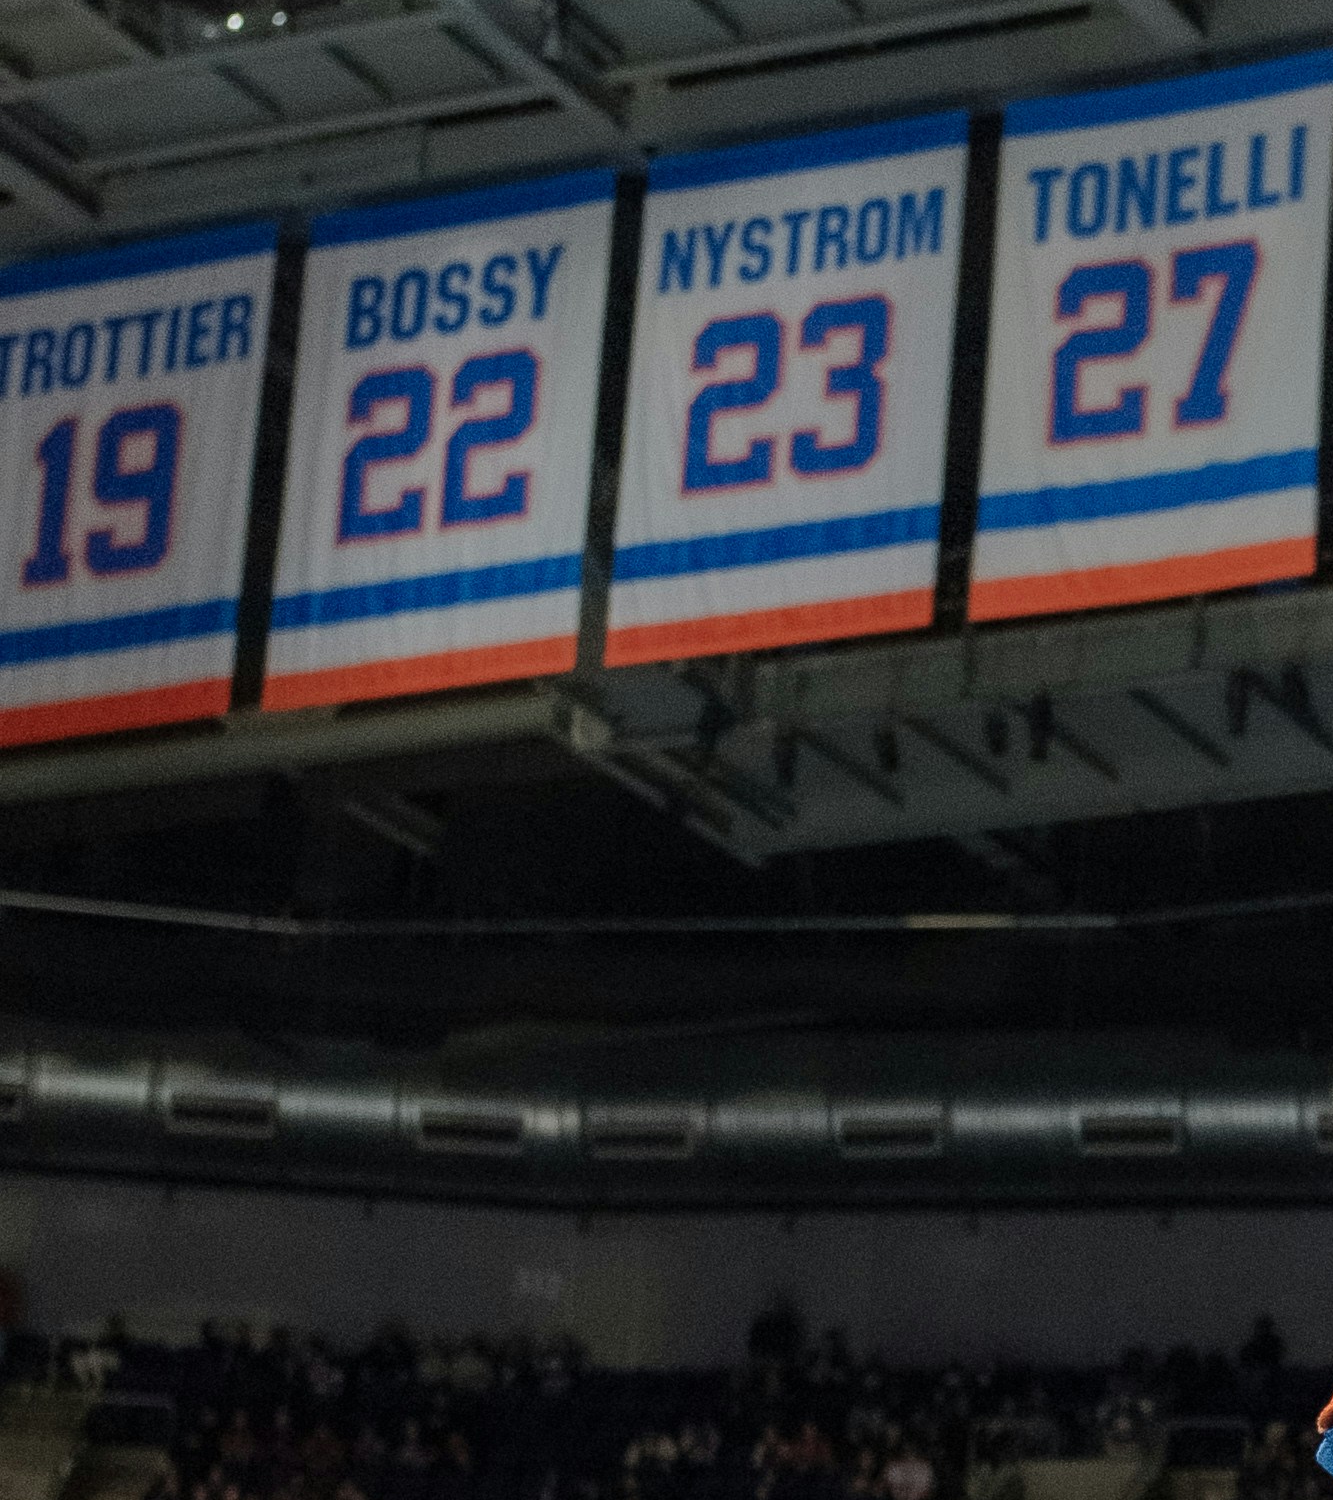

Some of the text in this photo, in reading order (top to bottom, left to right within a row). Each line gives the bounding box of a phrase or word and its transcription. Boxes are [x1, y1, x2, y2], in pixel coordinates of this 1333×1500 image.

[656, 187, 947, 296] NYSTROM
[1027, 125, 1308, 245] TONELLI
[0, 293, 254, 399] TROTTIER
[344, 243, 565, 352] BOSSY
[1045, 237, 1262, 449] 27
[335, 348, 543, 549] 22
[680, 293, 893, 496] 23
[21, 401, 185, 590] 19
